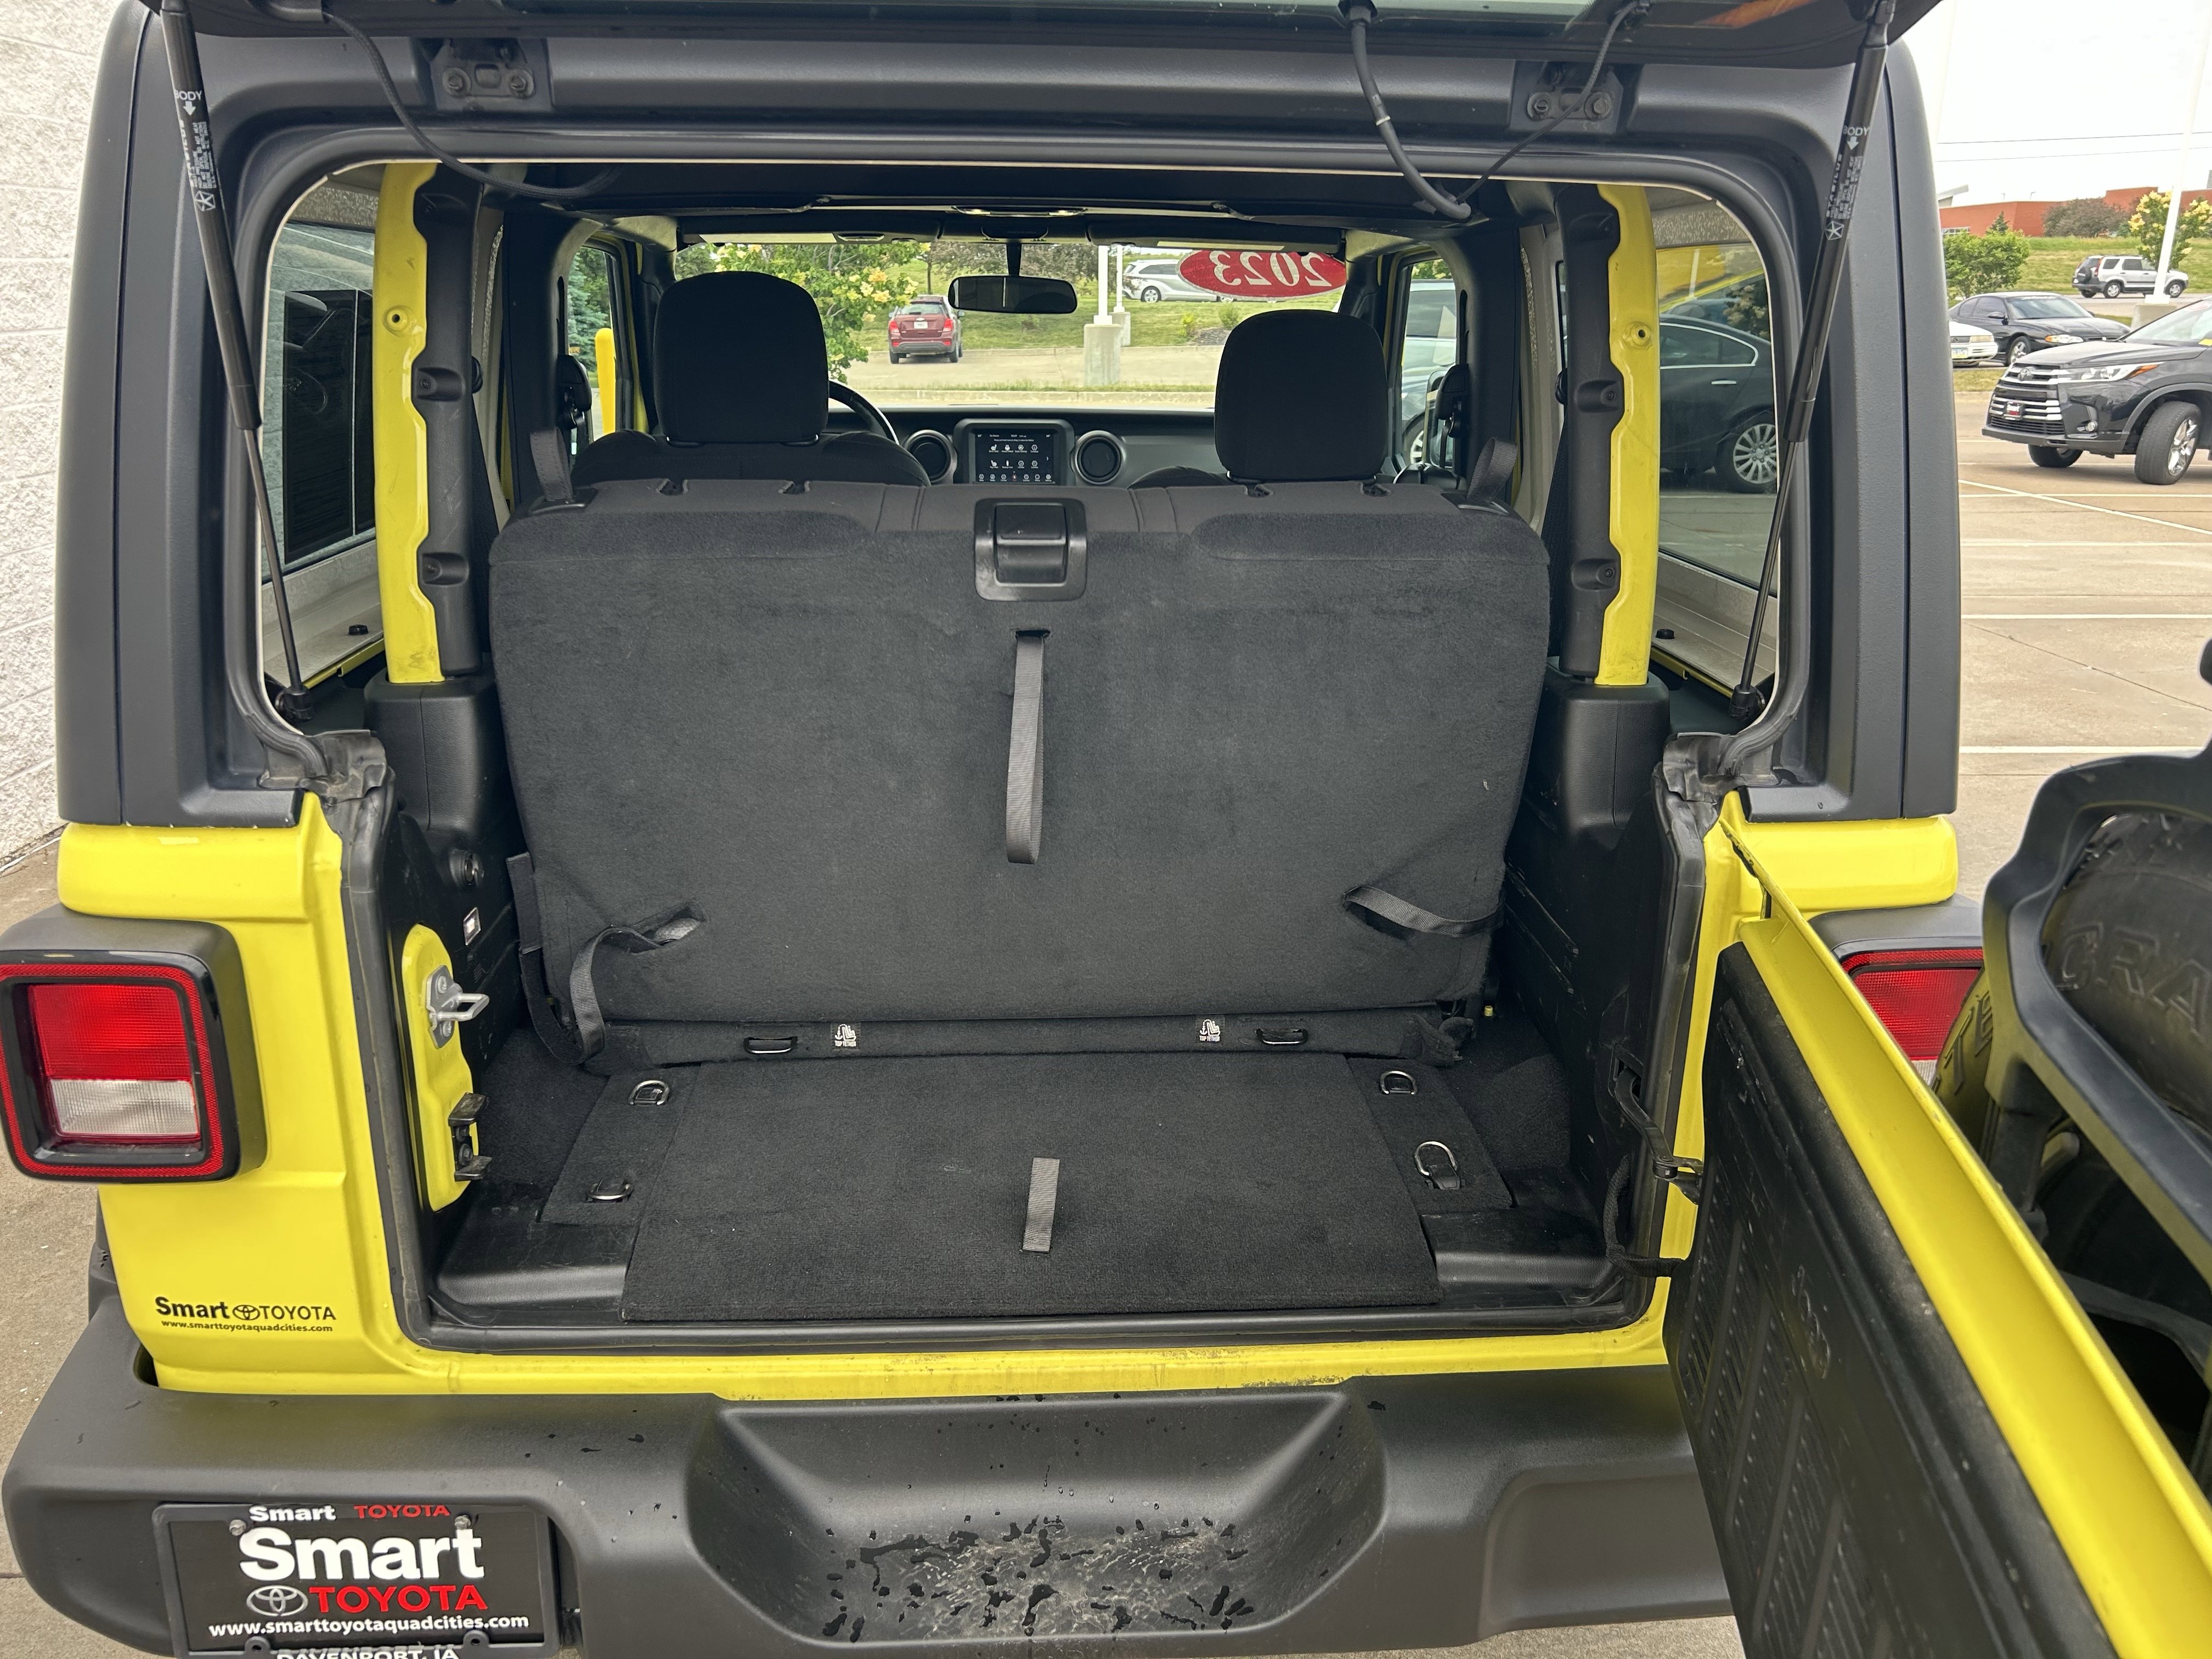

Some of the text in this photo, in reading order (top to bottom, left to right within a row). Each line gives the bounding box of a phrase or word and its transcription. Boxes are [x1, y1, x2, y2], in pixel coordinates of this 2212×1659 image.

[174, 90, 202, 100] BODY
[1843, 126, 1870, 136] BODY
[155, 1296, 337, 1321] Smart TOYOTA
[161, 1320, 333, 1332] www.smarttoyotaquadcities.com
[249, 1504, 451, 1521] Smart TOYOTA
[239, 1527, 485, 1581] Smart
[309, 1584, 488, 1613] TOYOTA
[208, 1615, 529, 1636] www.smarttoyotaquadcities.com
